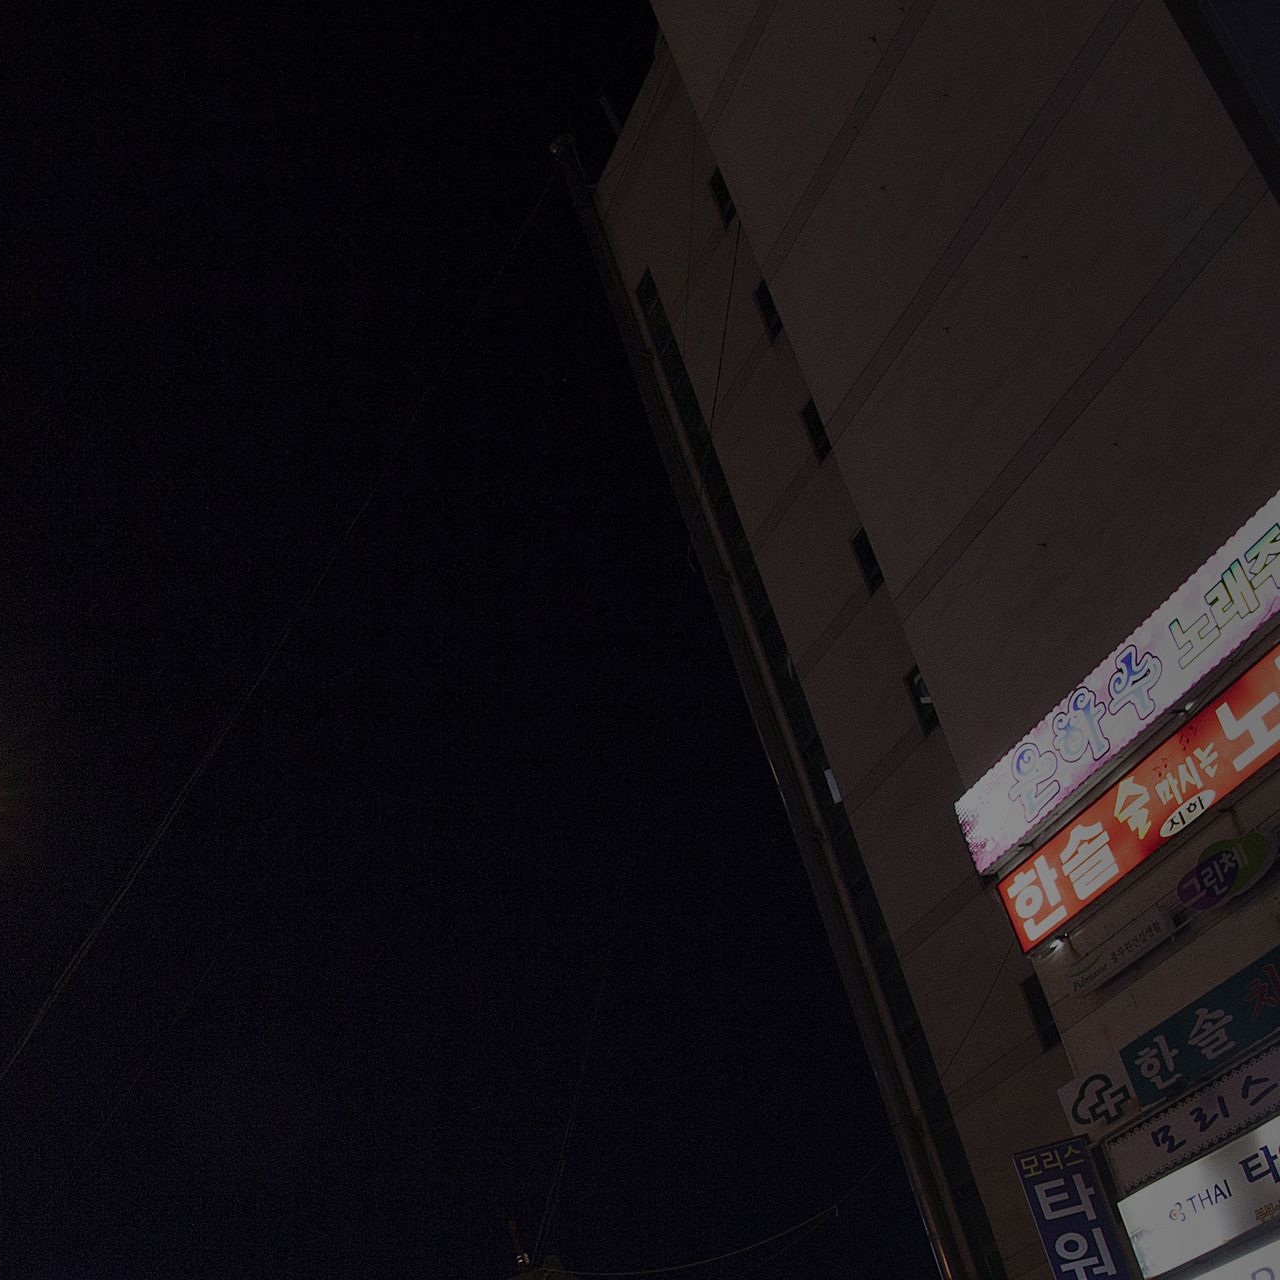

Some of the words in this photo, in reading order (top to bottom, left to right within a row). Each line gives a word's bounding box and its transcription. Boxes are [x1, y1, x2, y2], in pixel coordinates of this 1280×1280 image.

[1008, 645, 1163, 822] 은하수
[1006, 822, 1120, 943] 한솔
[1114, 776, 1152, 840] 술
[1154, 742, 1219, 806] 마시는
[1134, 1007, 1235, 1092] 한솔
[1151, 1074, 1279, 1153] 모리스
[1021, 1142, 1085, 1178] 모리스
[1185, 1179, 1232, 1214] THAI
[1238, 1145, 1280, 1184] 타
